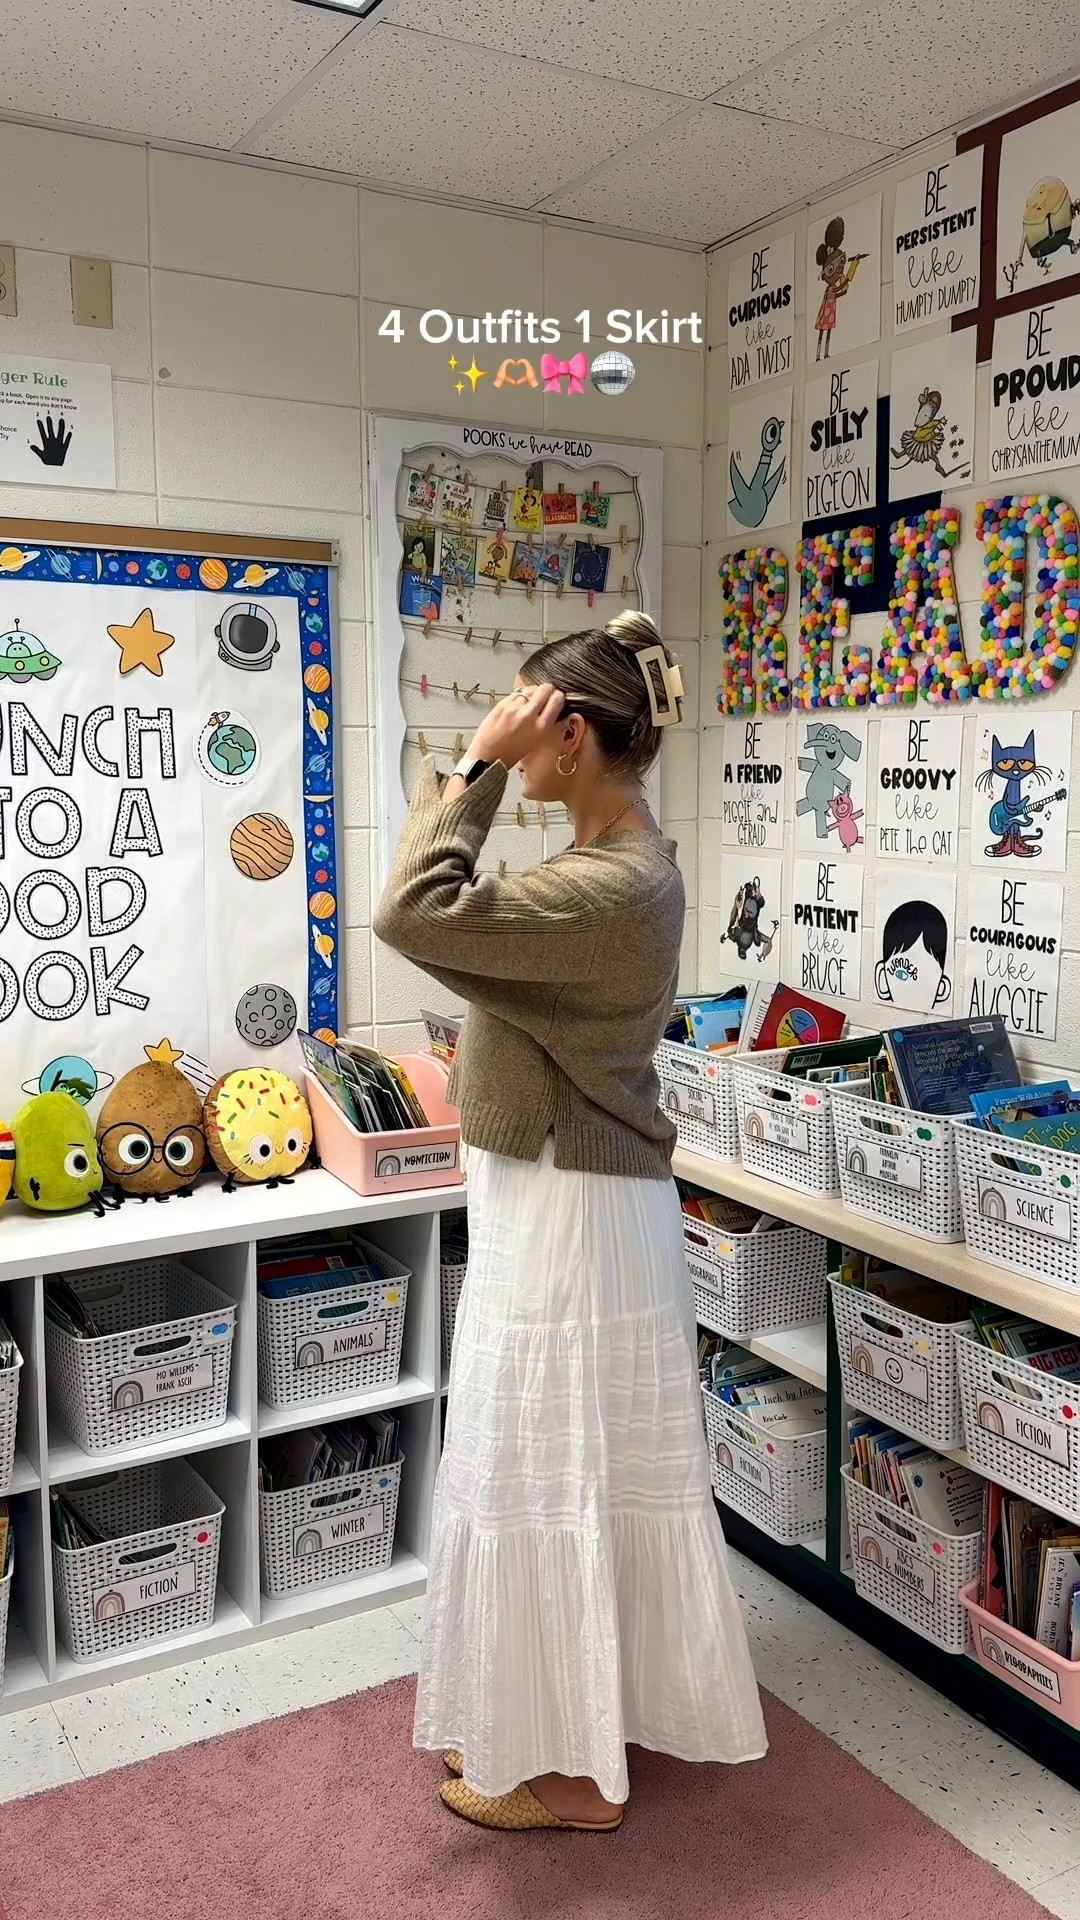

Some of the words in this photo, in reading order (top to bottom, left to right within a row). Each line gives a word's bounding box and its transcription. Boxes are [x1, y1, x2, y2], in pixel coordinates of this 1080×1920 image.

[924, 164, 950, 218] BE
[896, 206, 977, 254] PERSISTENT
[751, 246, 770, 292] BE
[908, 247, 963, 288] like
[728, 284, 792, 328] CURIOUS
[896, 290, 934, 325] HUMPTY
[938, 276, 977, 311] DUMPTY
[745, 321, 776, 347] like
[1026, 305, 1055, 360] BE
[730, 351, 751, 391] ADA
[756, 336, 792, 380] TWIST
[32, 372, 68, 388] Rule
[829, 369, 851, 416] BE
[993, 354, 1080, 407] PROUD
[809, 406, 869, 452] SILLY
[1007, 400, 1069, 440] like
[463, 427, 506, 448] BOOKS
[509, 437, 528, 451] we
[530, 436, 563, 454] have
[564, 440, 593, 458] READ
[822, 445, 855, 470] like
[807, 467, 870, 518] PIGEON
[717, 494, 1080, 717] READ
[0, 702, 177, 779] NCH
[745, 721, 763, 759] BE
[908, 719, 931, 762] BE
[724, 763, 733, 783] A
[737, 764, 782, 784] FRIEND
[880, 767, 957, 790] GROOVY
[741, 784, 765, 801] like
[895, 793, 939, 821] like
[109, 787, 164, 859] A
[723, 800, 752, 824] PIGGIE
[757, 800, 779, 824] and
[737, 822, 766, 847] GERALD
[880, 827, 900, 851] PETE
[932, 830, 952, 855] CAT
[816, 862, 837, 902] BE
[0, 866, 147, 941] OD
[794, 903, 858, 933] PATIENT
[1001, 879, 1027, 926] BE
[807, 927, 844, 954] like
[969, 925, 1057, 954] COURAGOUS
[802, 952, 848, 996] BRUCE
[986, 949, 1036, 982] like
[968, 976, 1048, 1034] AUGGIE
[1041, 1124, 1053, 1137] THE
[1050, 1121, 1077, 1150] DOG
[404, 1151, 451, 1167] NONFICTION
[1016, 1198, 1054, 1227] SCIENCE
[333, 1332, 374, 1354] ANIMALS
[156, 1370, 167, 1380] MO
[169, 1363, 194, 1377] WILLEMS
[1027, 1353, 1055, 1371] BIG
[156, 1380, 175, 1392] FRANK
[178, 1375, 192, 1388] ASCH
[785, 1389, 796, 1402] by
[1015, 1418, 1052, 1450] FICTION
[740, 1456, 762, 1484] FICTION
[331, 1516, 365, 1539] WINTER
[139, 1576, 178, 1599] FICTION
[894, 1563, 925, 1592] NUMBERS
[1004, 1650, 1053, 1691] BIOGRAPHIES
